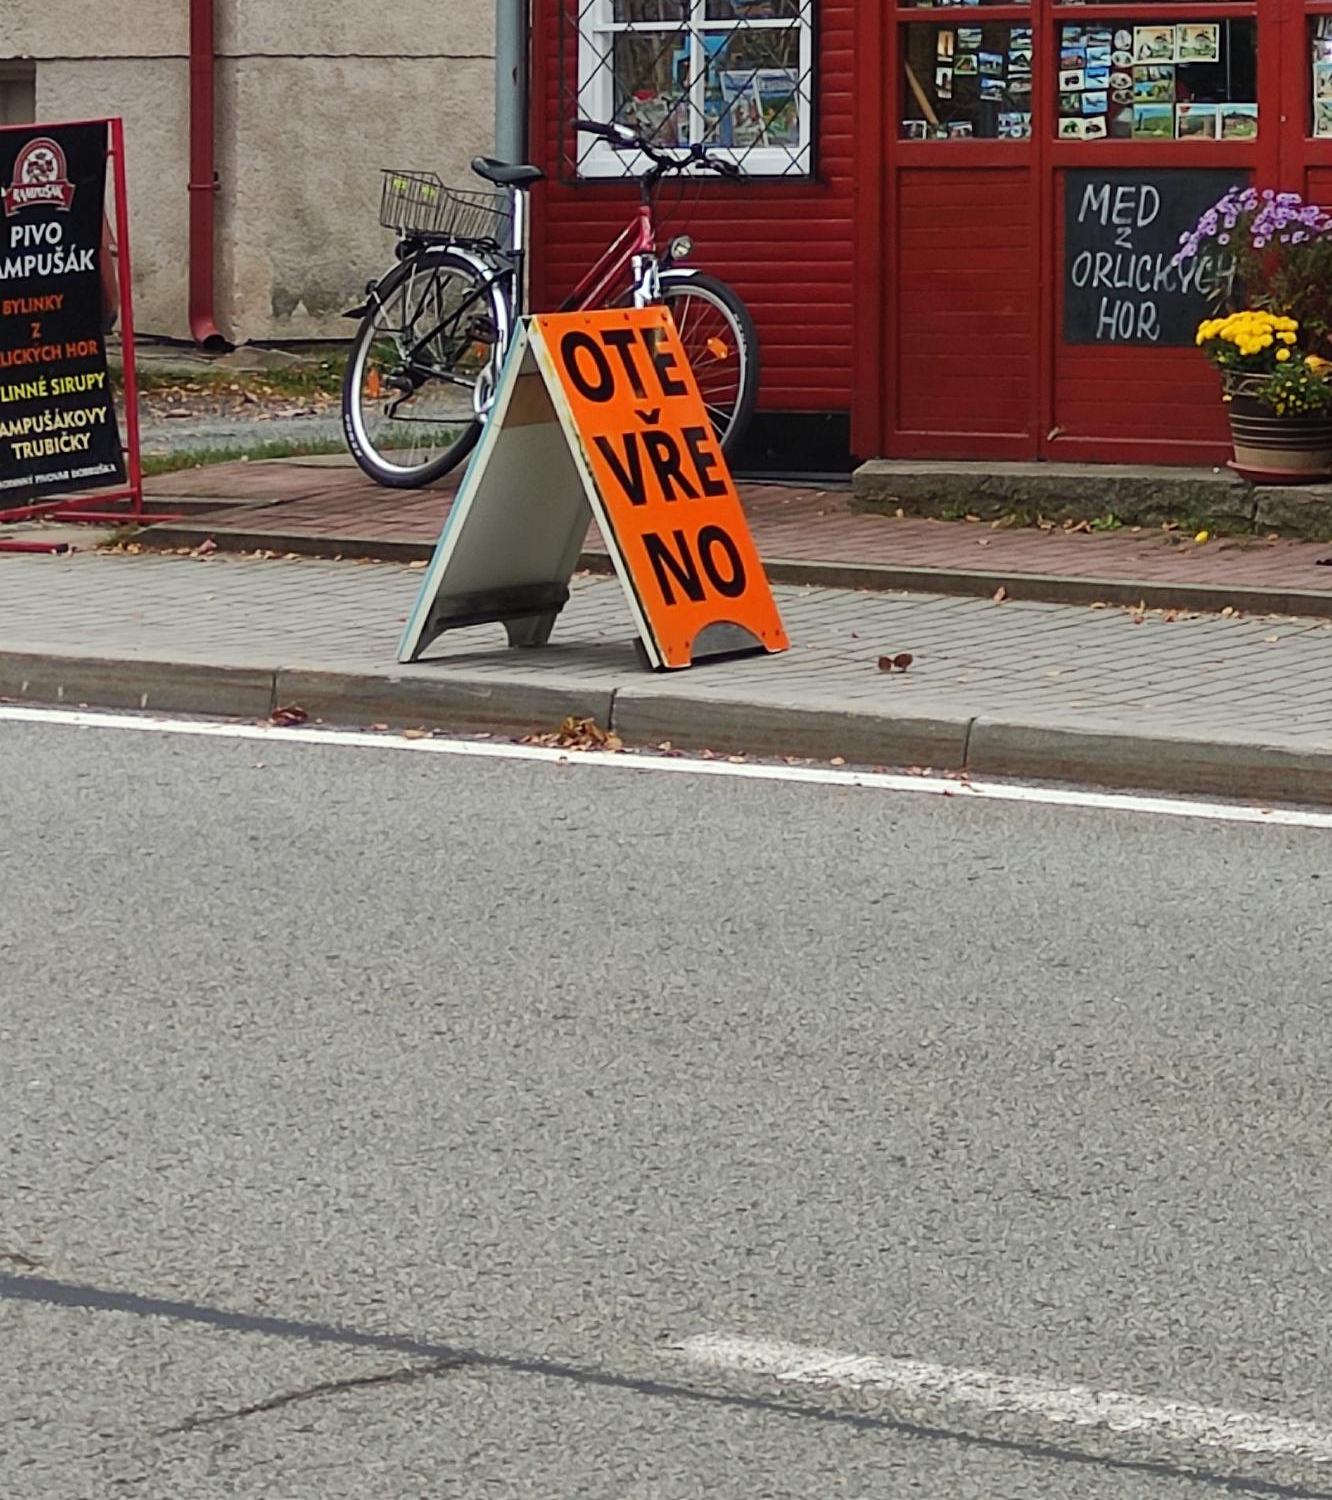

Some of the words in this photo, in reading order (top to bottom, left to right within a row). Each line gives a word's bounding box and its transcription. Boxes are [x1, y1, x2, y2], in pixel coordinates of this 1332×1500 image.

[1078, 183, 1160, 227] MED
[10, 221, 63, 249] PIVO
[0, 244, 96, 280] MPUŠÁK
[2, 294, 65, 316] BYLINKY
[1096, 296, 1160, 342] HOR
[30, 321, 43, 340] Z
[0, 341, 63, 368] LICKÝCH
[65, 340, 99, 359] HOR
[559, 327, 689, 404] OTE
[0, 375, 49, 403] LINNÉ
[51, 371, 106, 397] SIRUPY
[0, 405, 108, 439] AMPUŠÁKOVY
[10, 431, 92, 461] TRUBIČKY
[592, 406, 729, 508] VŘE
[640, 523, 748, 607] NO
